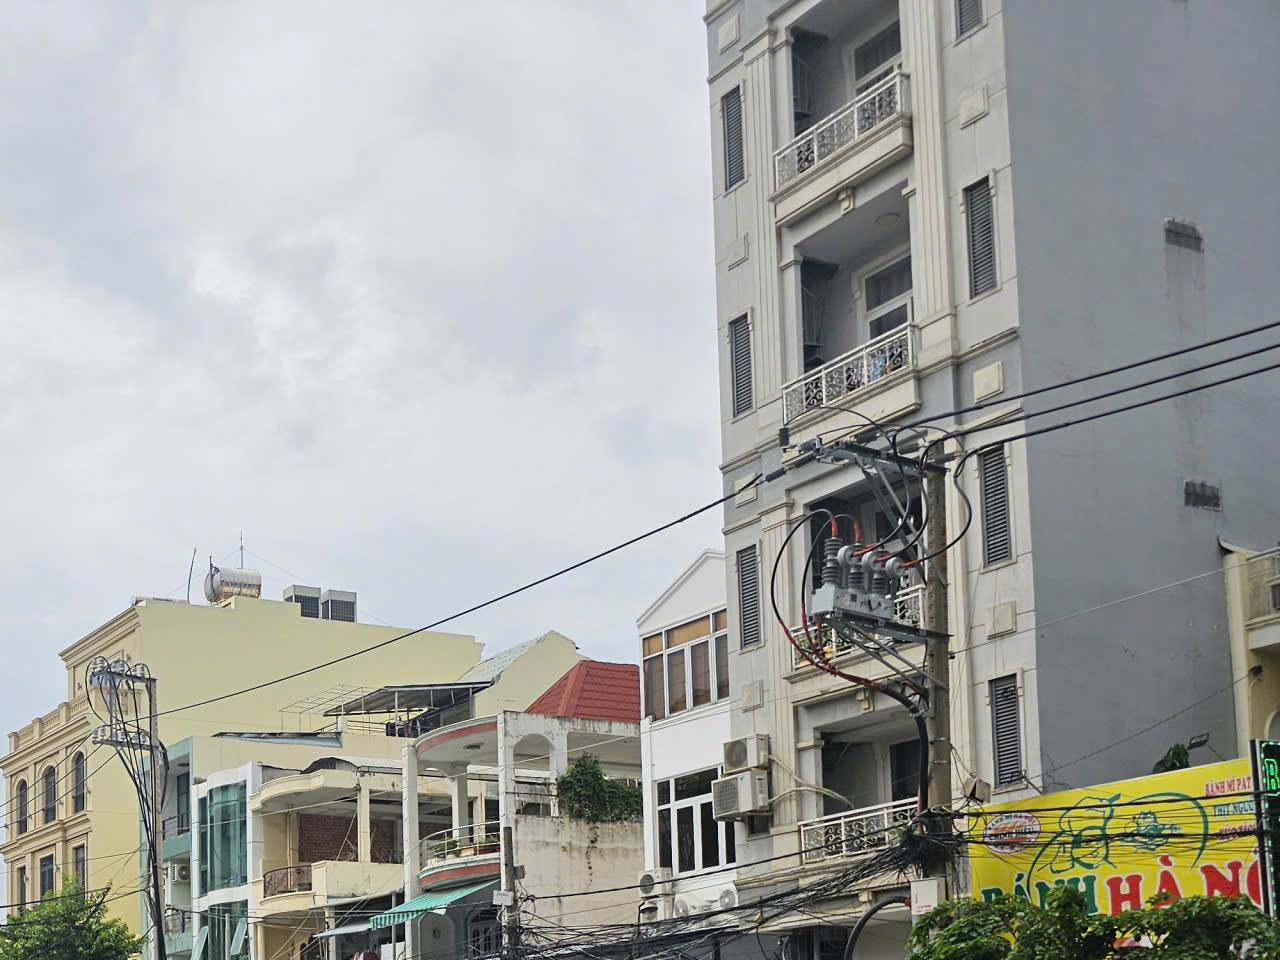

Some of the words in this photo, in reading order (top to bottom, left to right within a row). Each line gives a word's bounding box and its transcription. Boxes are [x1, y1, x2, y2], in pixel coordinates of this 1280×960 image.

[1205, 779, 1225, 797] BÁNH
[1237, 776, 1252, 790] PAT
[1106, 855, 1182, 916] HÀ
